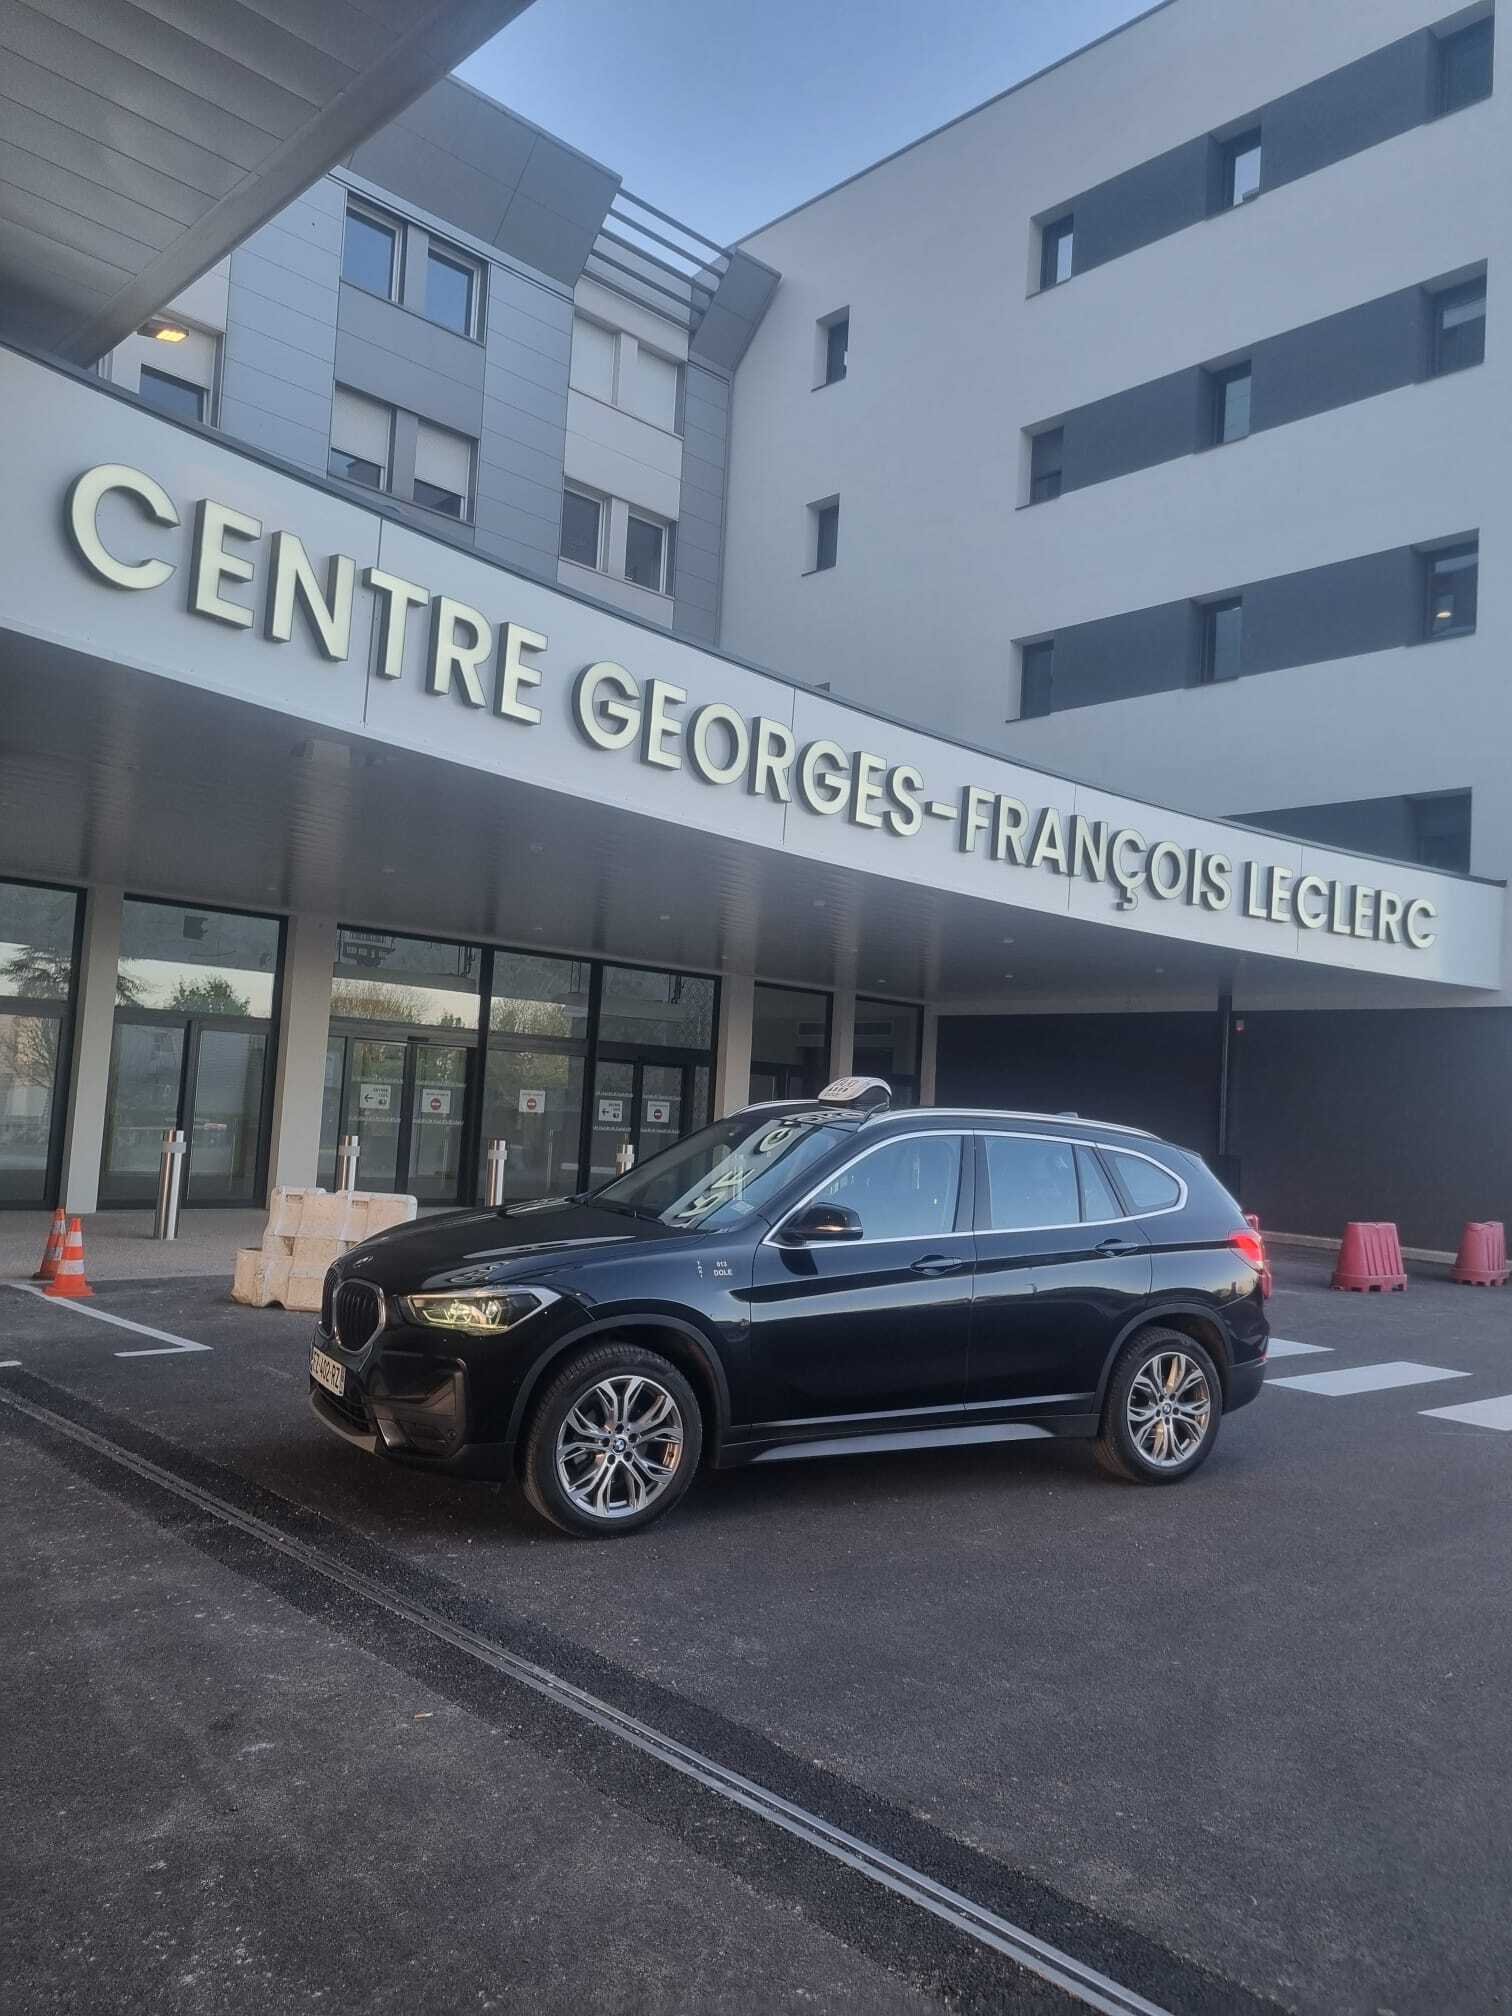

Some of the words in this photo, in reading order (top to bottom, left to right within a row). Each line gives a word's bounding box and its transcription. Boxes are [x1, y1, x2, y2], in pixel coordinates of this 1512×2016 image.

[68, 463, 548, 726] CENTRE
[572, 660, 1232, 911] GEORGES-FRANÇOIS
[1245, 861, 1439, 949] LECLERC
[713, 1268, 733, 1276] DOLE
